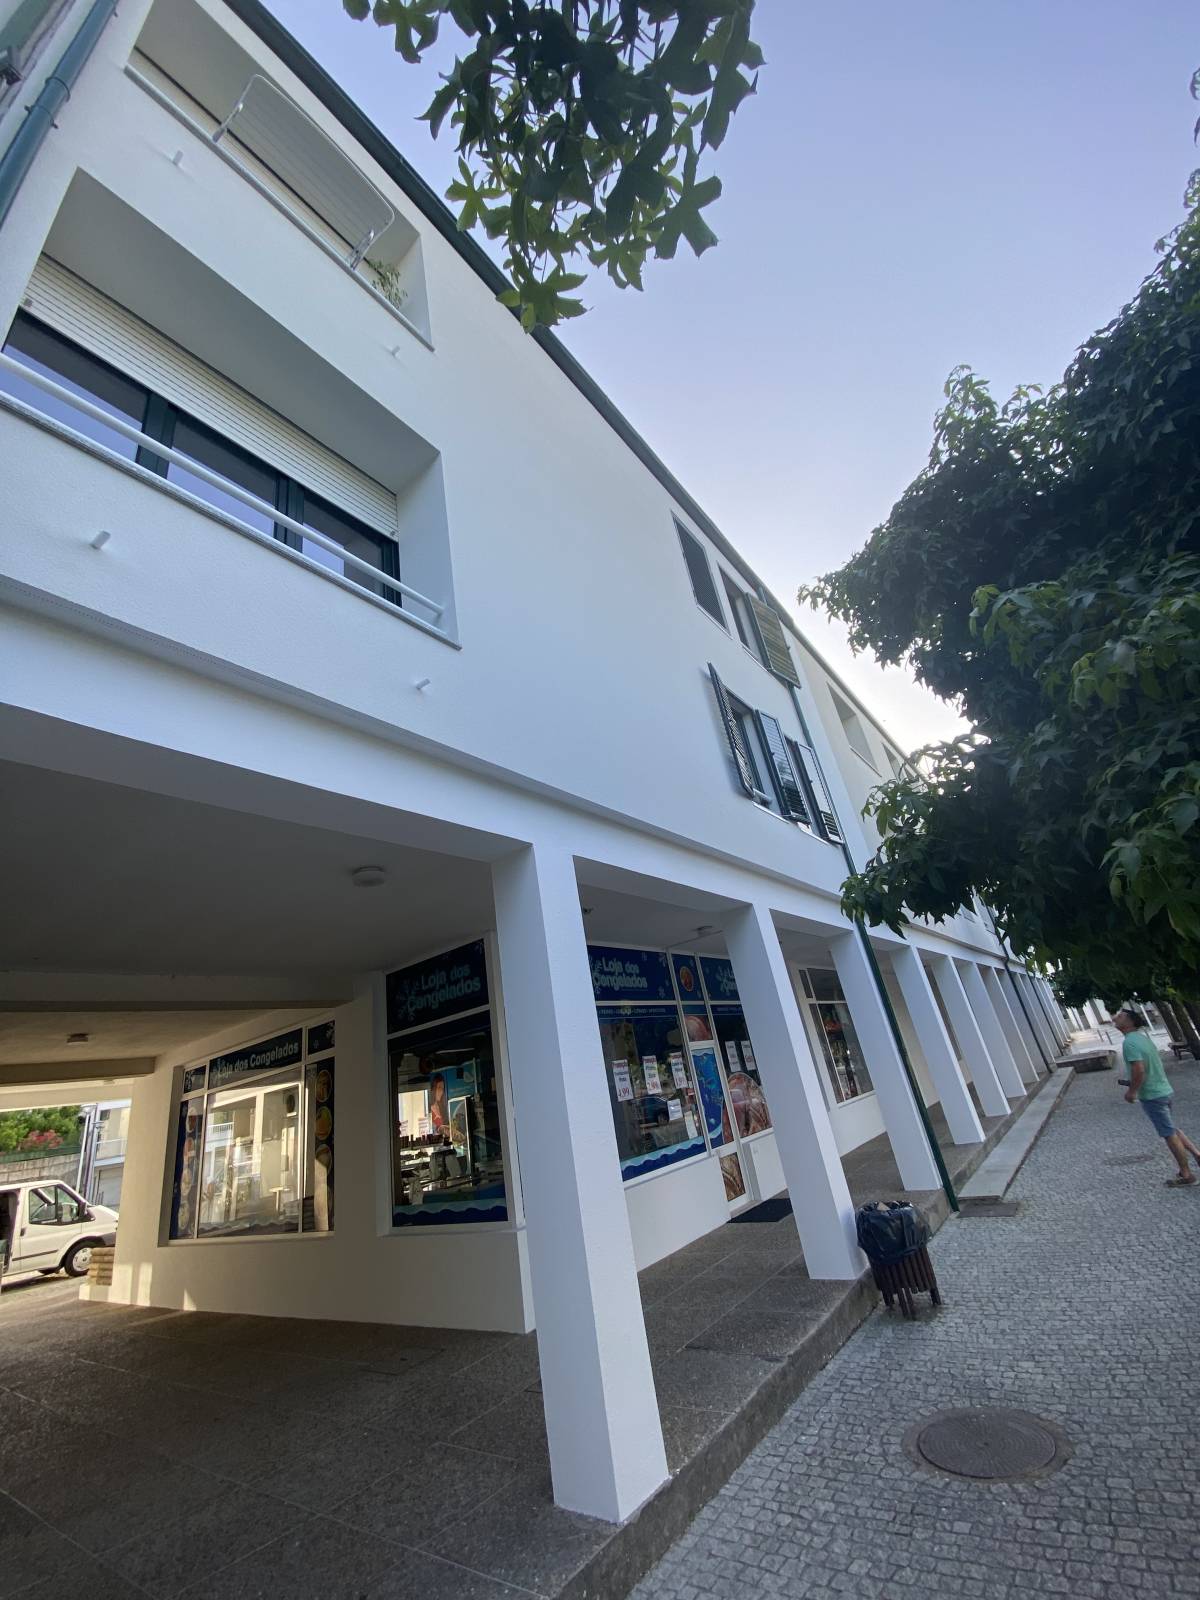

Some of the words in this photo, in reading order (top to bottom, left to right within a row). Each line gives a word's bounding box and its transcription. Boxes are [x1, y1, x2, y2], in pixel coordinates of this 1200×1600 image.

[421, 967, 447, 990] Loja
[450, 963, 471, 981] dos
[602, 957, 624, 975] Loja
[625, 961, 640, 975] dos
[407, 976, 481, 1010] Congelados
[593, 971, 648, 991] Congelados
[234, 1058, 249, 1073] dos
[249, 1041, 299, 1067] Congelados
